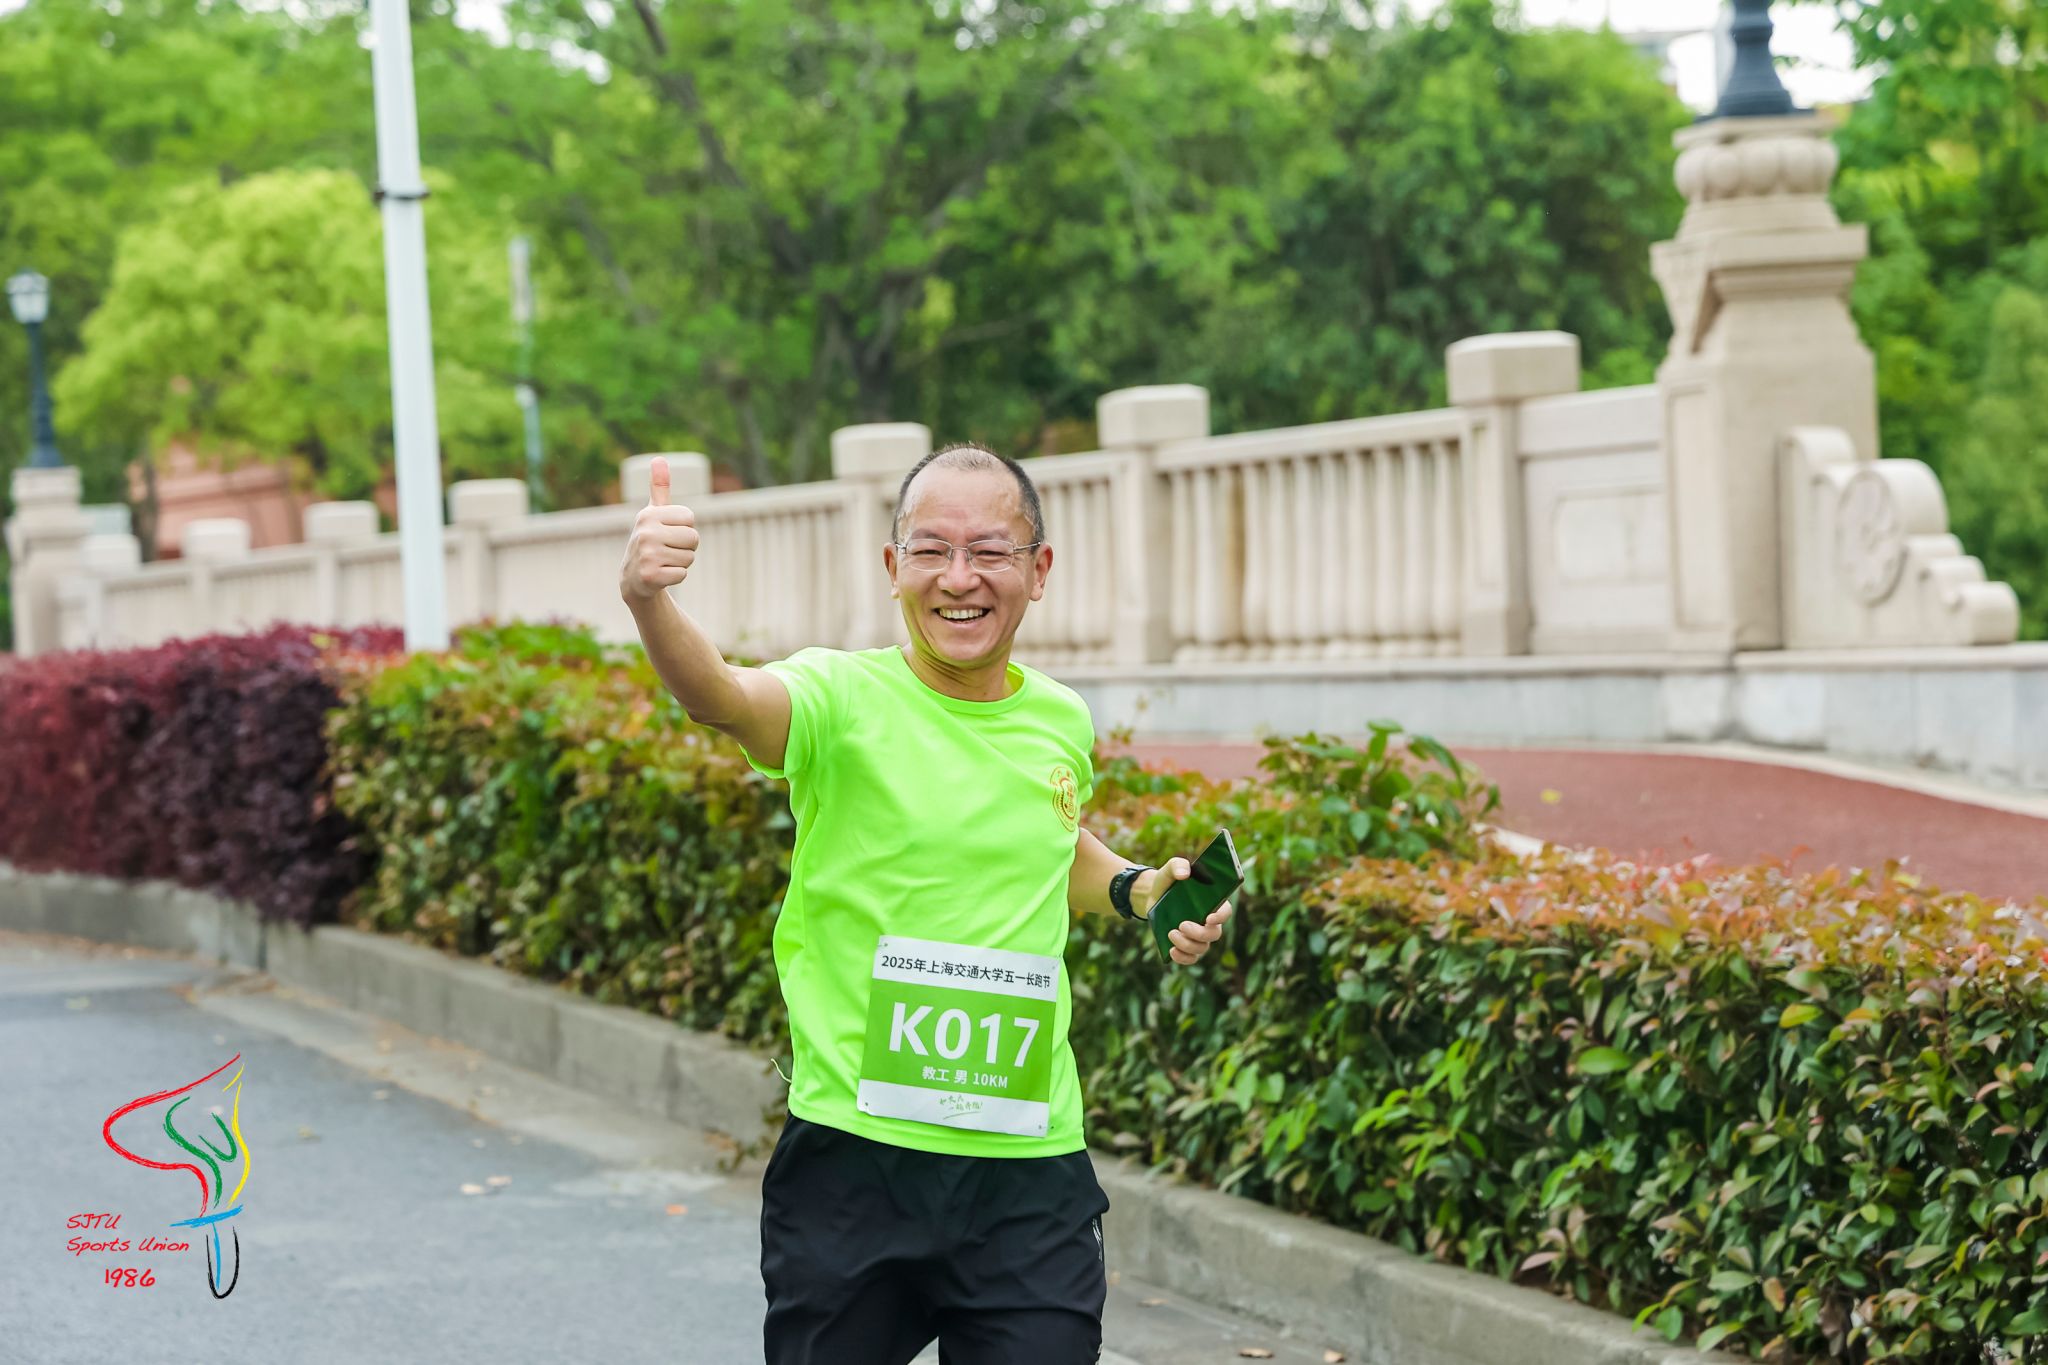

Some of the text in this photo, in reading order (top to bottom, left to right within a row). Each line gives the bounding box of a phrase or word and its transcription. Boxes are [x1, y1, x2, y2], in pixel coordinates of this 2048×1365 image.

[881, 955, 1051, 989] 2025年上海交通大学五一长跑节
[888, 1001, 1040, 1069] K017
[922, 1065, 1008, 1089] 教工 男 10KM
